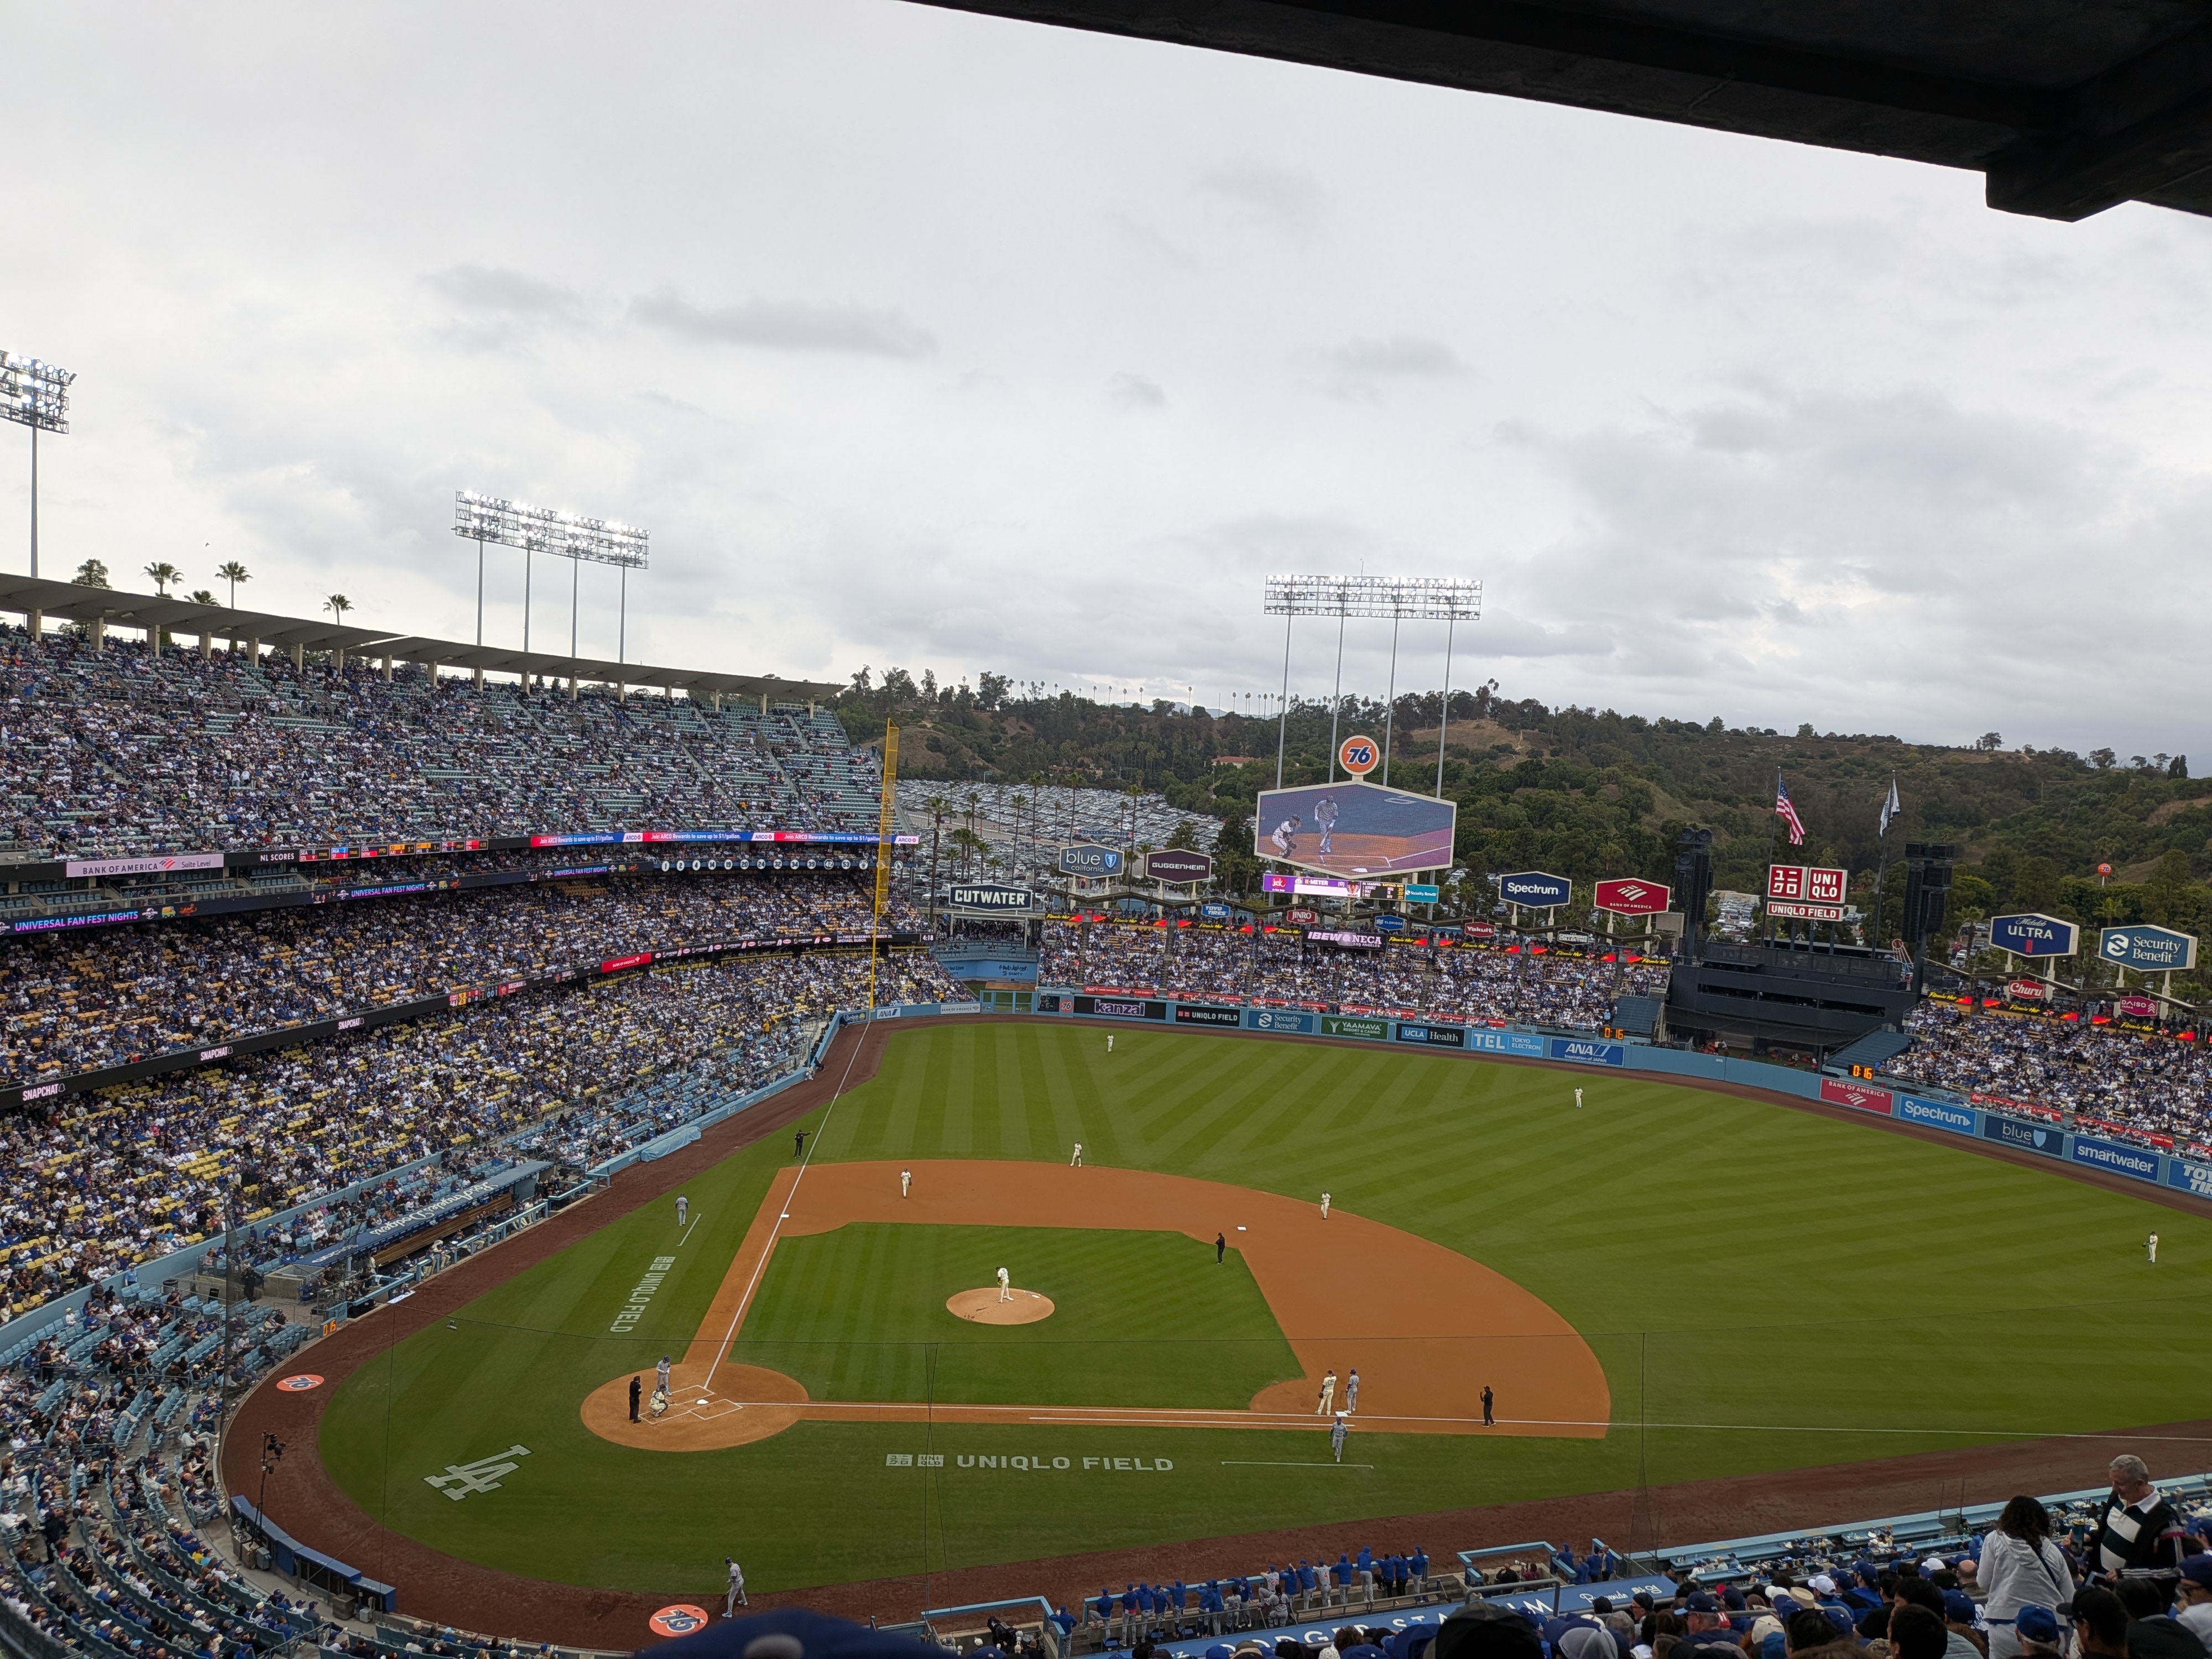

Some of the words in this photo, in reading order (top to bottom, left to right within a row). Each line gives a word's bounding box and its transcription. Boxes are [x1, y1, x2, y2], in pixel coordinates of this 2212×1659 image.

[1346, 745, 1371, 765] 76
[196, 859, 211, 868] Level
[1066, 849, 1100, 865] blue
[82, 867, 107, 875] BANK
[108, 865, 120, 874] OF
[121, 863, 158, 873] AMERICA
[1071, 864, 1104, 873] california
[1152, 862, 1206, 871] GUGGENHEIM
[1272, 878, 1286, 887] Jack
[1774, 869, 1797, 882] ユニ
[1813, 873, 1836, 886] UNI
[351, 889, 382, 898] UNIVERSAL
[406, 884, 425, 892] NIGHTS
[1507, 883, 1558, 896] Spectrum
[1772, 881, 1797, 894] クロ
[1811, 885, 1838, 899] QLO
[954, 889, 1026, 906] CUTWATER
[1292, 911, 1312, 920] JINRO
[1771, 905, 1806, 917] UNIQLO
[1808, 907, 1837, 919] FIELD
[15, 919, 66, 931] UNIVERSAL
[67, 916, 85, 926] FAN
[86, 914, 107, 924] FEST
[107, 911, 138, 922] NIGHTS
[2015, 917, 2046, 927] Michelob
[1307, 931, 1343, 942] IBEW
[1352, 935, 1382, 945] NECA
[2007, 925, 2053, 940] ULTRA
[2133, 936, 2181, 953] Security
[2132, 948, 2173, 964] Benefit
[2010, 982, 2043, 997] Churu
[1061, 1001, 1072, 1010] 76
[2121, 1000, 2146, 1008] DAISO
[1192, 1011, 1216, 1020] UNIQLO
[1218, 1013, 1238, 1021] FIELD
[1274, 1013, 1302, 1025] Security
[338, 1018, 361, 1030] SNAPCHAT
[1274, 1021, 1297, 1030] Benefit
[1405, 1029, 1425, 1039] UCLA
[1429, 1032, 1459, 1043] Health
[1604, 1027, 1624, 1040] 0:16
[1474, 1034, 1505, 1050] TEL
[1511, 1042, 1541, 1051] ELECTRON
[200, 1046, 228, 1061] SNAPCHAT
[1565, 1043, 1595, 1057] ANA
[1853, 1065, 1872, 1080] 0:16
[23, 1084, 59, 1101] SNAPCHAT
[1829, 1081, 1846, 1090] BANK
[1856, 1087, 1885, 1098] AMERICA
[1905, 1100, 1967, 1126] Spectrum
[2002, 1122, 2032, 1141] blue
[2002, 1135, 2032, 1146] CALIFORNIA
[2077, 1144, 2153, 1173] smartwater
[468, 1181, 498, 1194] Los
[422, 1190, 474, 1215] Angeles
[369, 1209, 435, 1235] Dodgers
[629, 1272, 667, 1303] UNIQLO
[609, 1305, 646, 1333] FIELD
[282, 1377, 320, 1390] 76
[956, 1454, 1071, 1471] UNIQLO
[1082, 1457, 1175, 1472] FIELD
[424, 1444, 533, 1502] LA
[654, 1608, 705, 1634] 76
